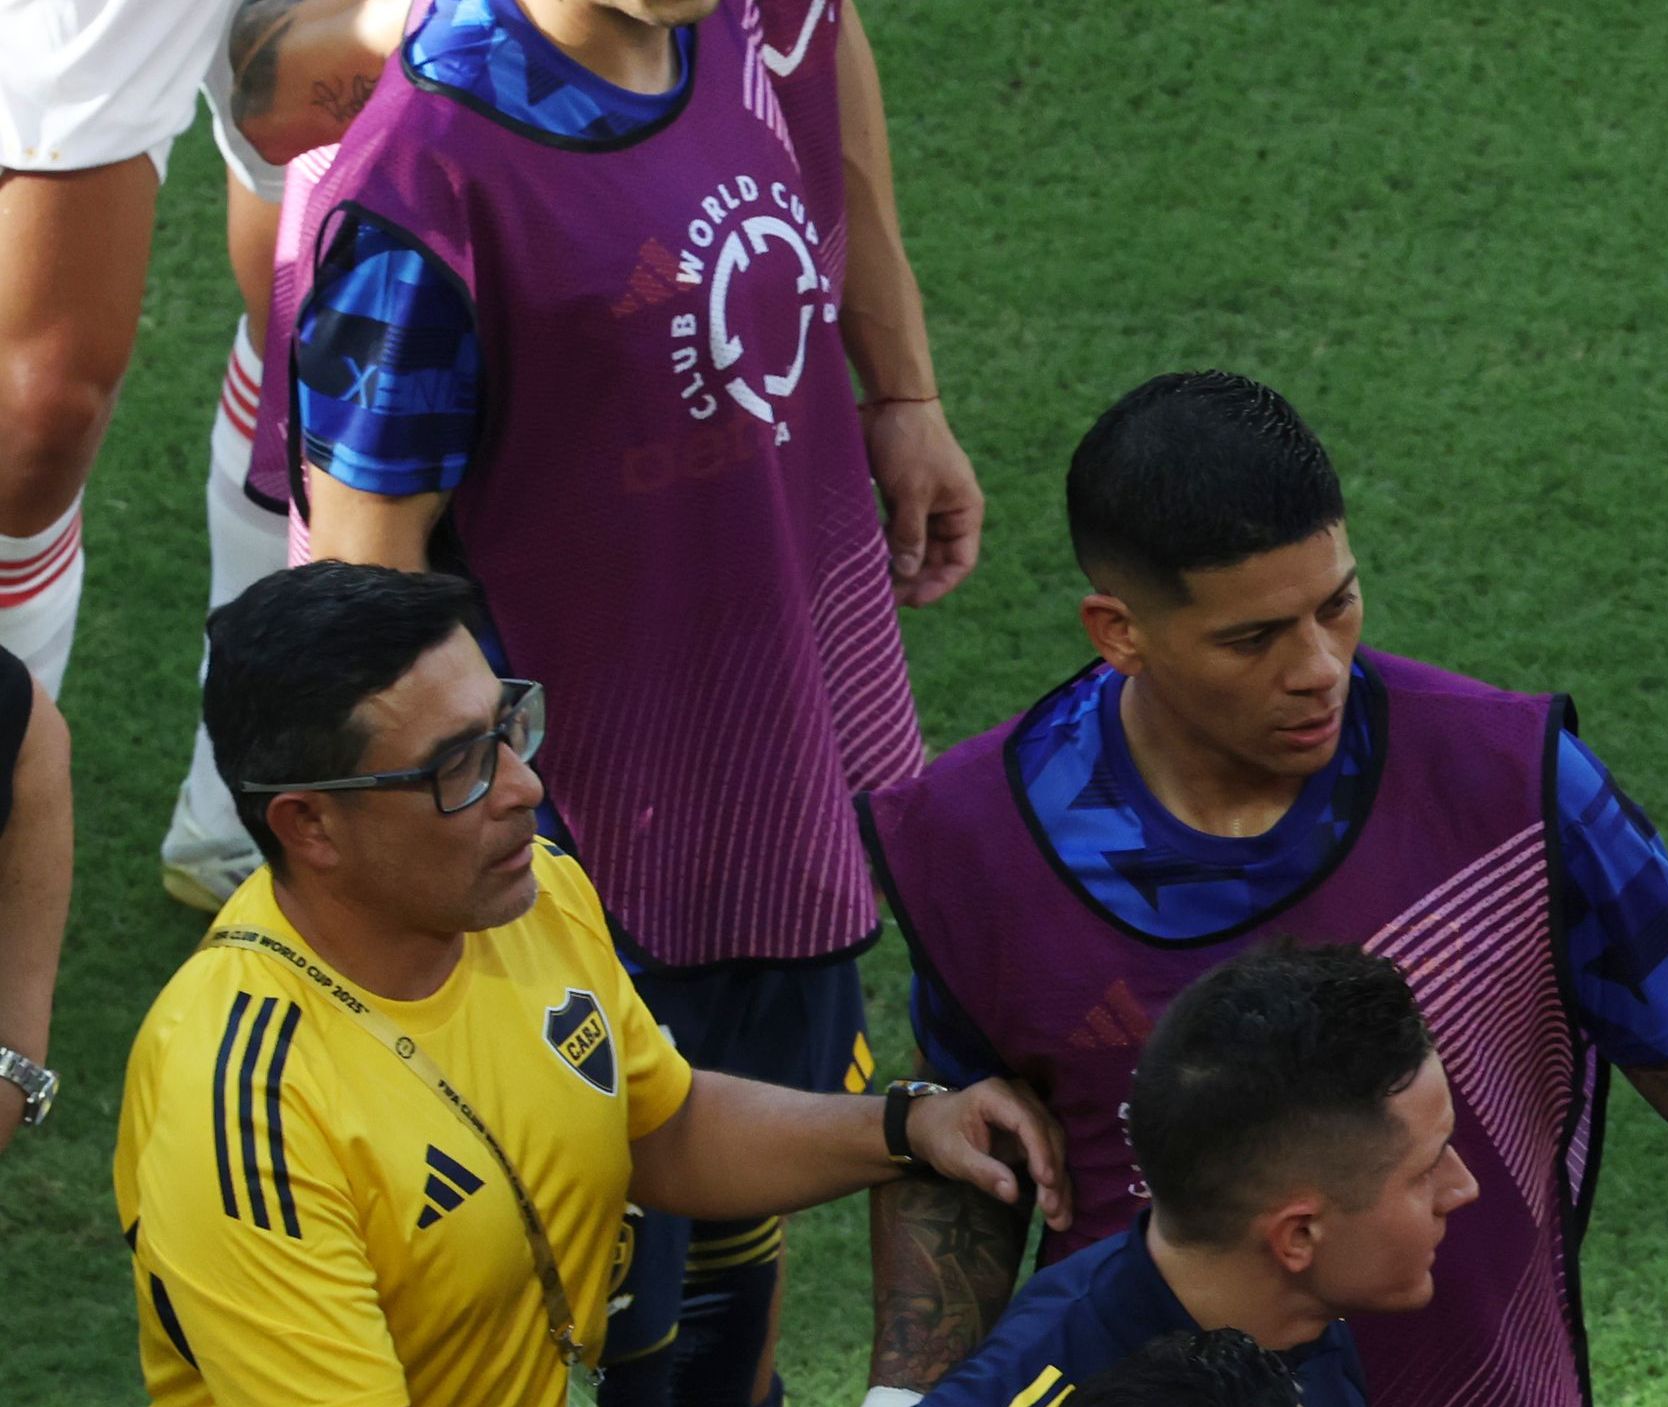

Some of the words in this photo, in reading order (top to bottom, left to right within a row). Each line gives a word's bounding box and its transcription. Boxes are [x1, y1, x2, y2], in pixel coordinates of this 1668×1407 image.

[676, 175, 758, 284] WORLD
[671, 313, 717, 420] CLUB
[260, 935, 307, 968] WORLD
[306, 966, 333, 988] CUP
[331, 985, 367, 1015] 2025
[566, 1018, 602, 1061] CABJ
